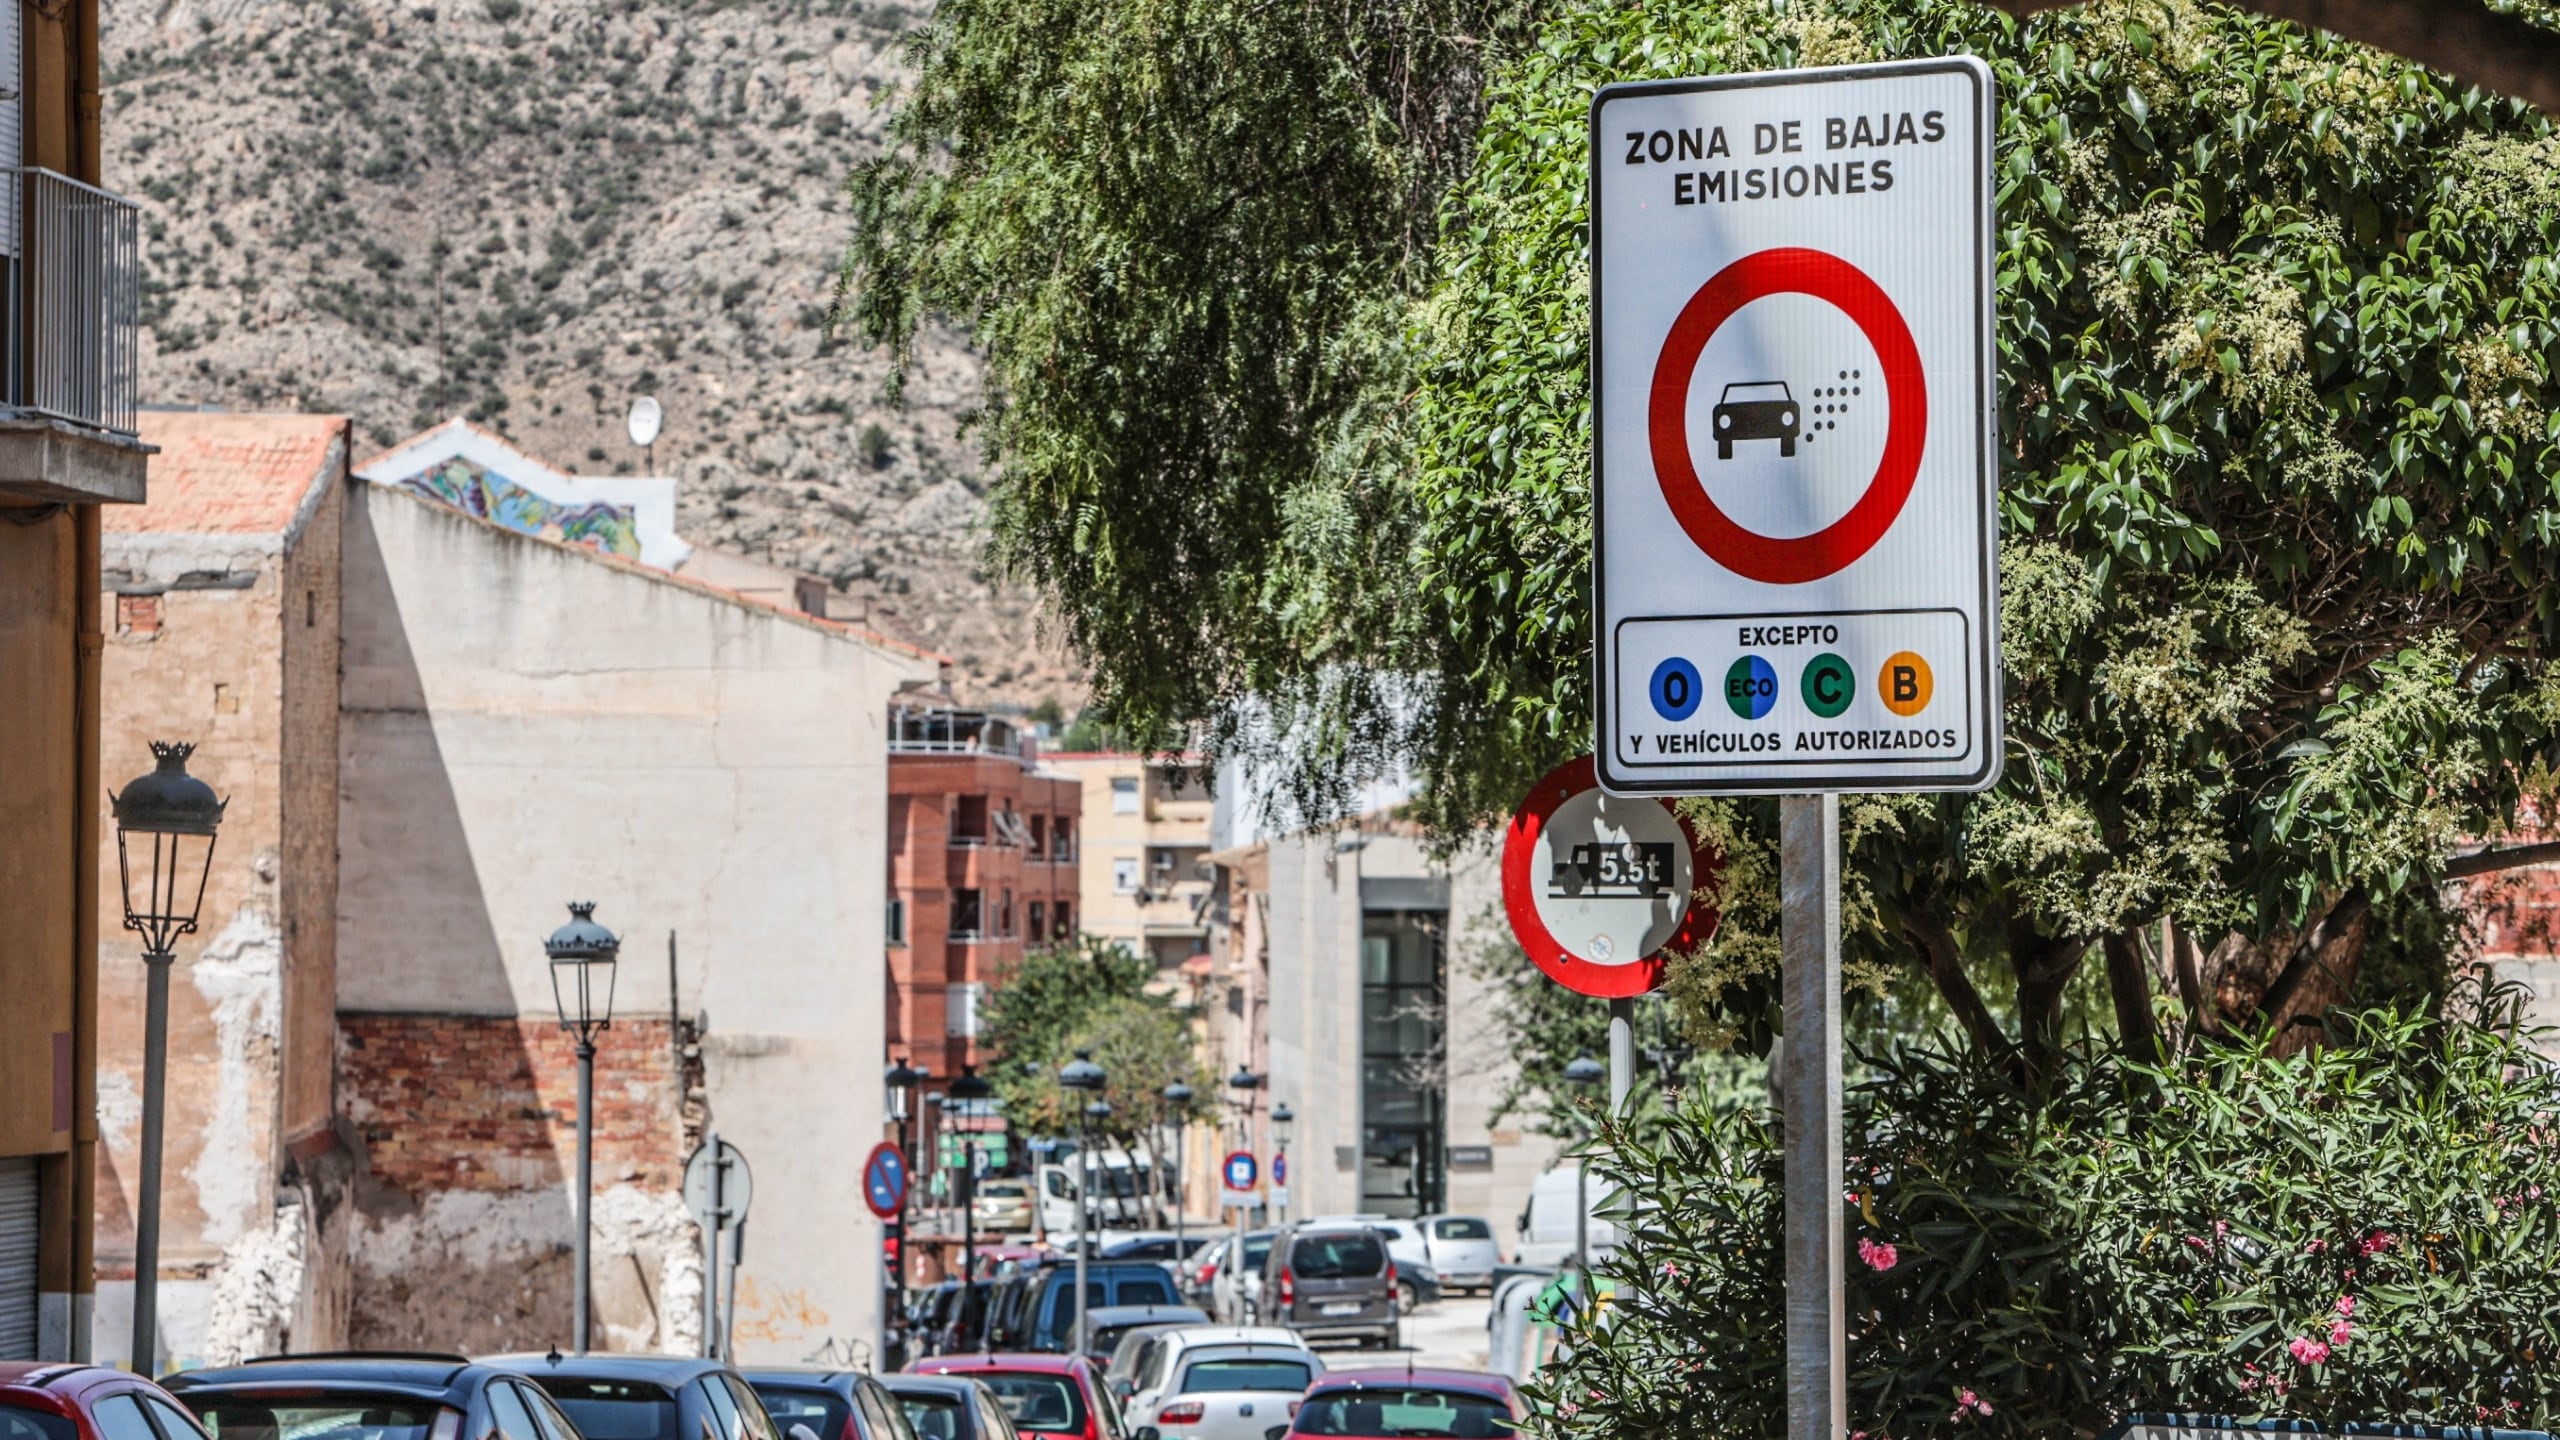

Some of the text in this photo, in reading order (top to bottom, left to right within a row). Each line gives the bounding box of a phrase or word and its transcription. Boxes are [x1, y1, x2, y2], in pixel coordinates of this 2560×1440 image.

[1625, 110, 1946, 165] ZONA DE BAJAS
[1674, 159, 1894, 205] EMISIONES
[1739, 624, 1839, 647] EXCEPTO
[1729, 677, 1773, 698] ECO
[1813, 667, 1843, 704] C
[1893, 665, 1919, 703] B
[1630, 729, 1957, 755] Y VEHÍCULOS AUTORIZADOS
